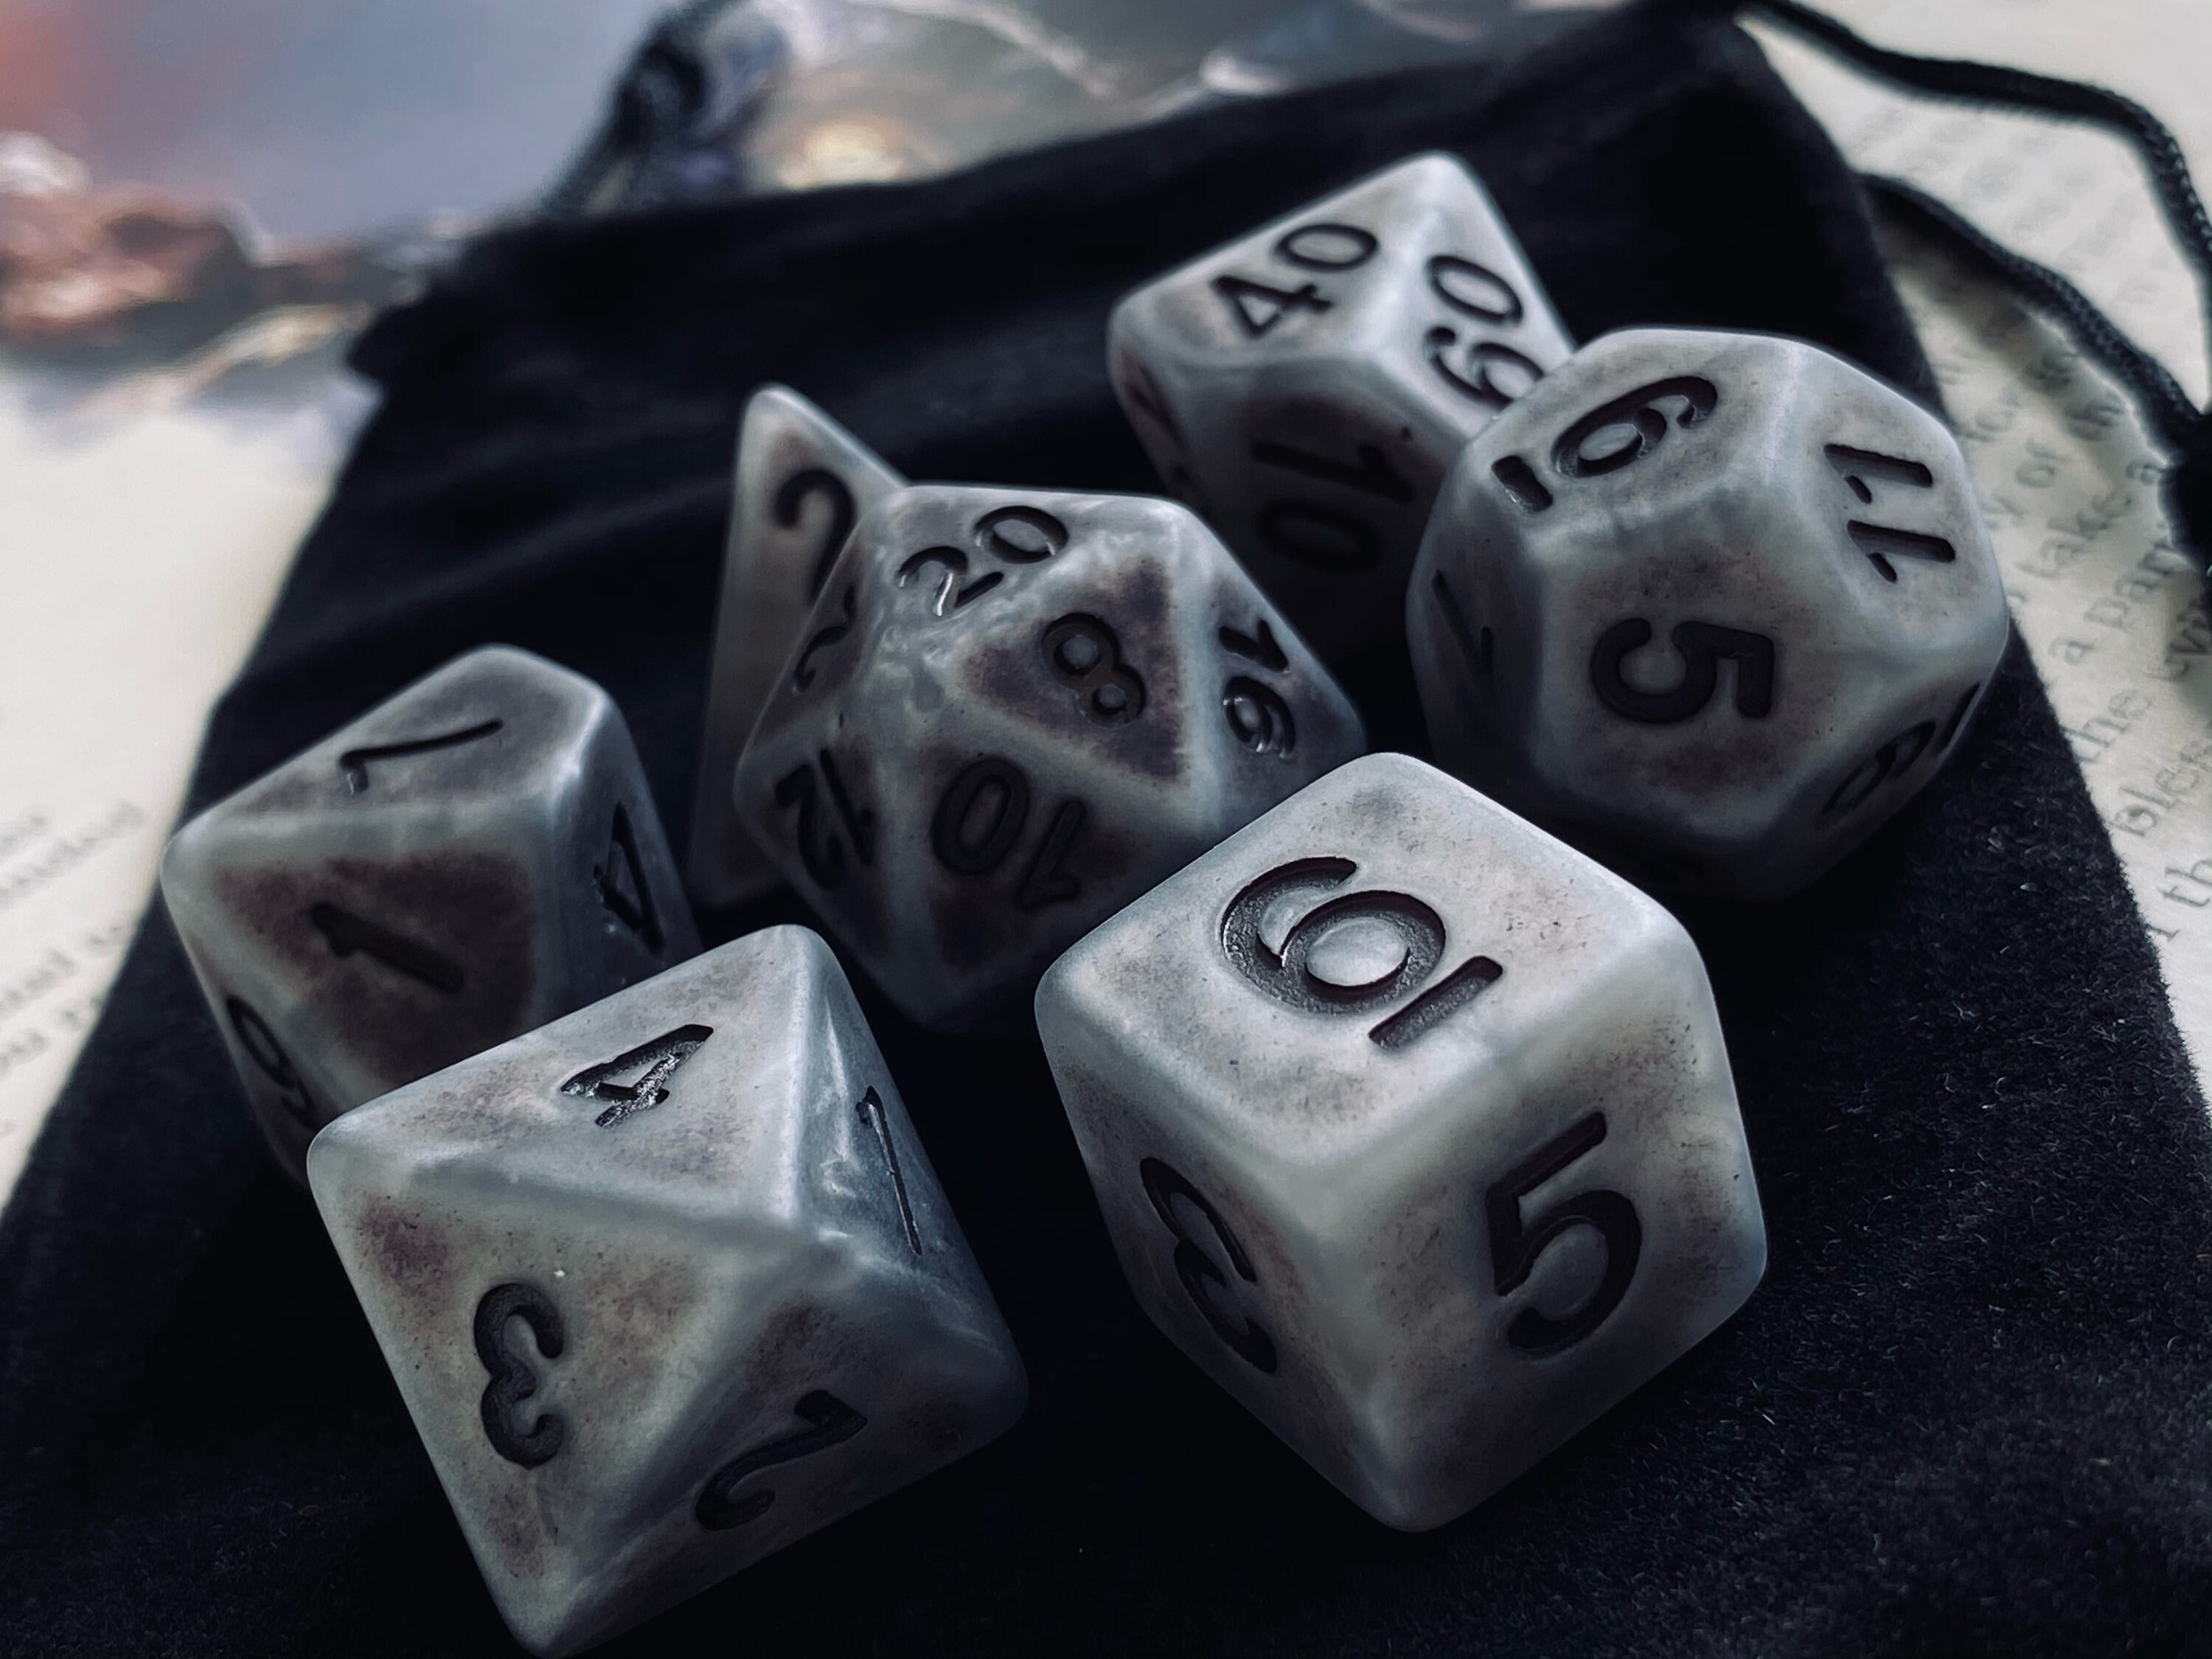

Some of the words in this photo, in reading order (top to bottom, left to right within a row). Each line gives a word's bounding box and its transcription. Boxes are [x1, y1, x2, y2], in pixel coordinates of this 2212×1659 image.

[1211, 223, 1379, 339] 40
[1425, 254, 1550, 408] 60
[895, 505, 1071, 618] 20
[1823, 442, 1957, 583] 11
[1040, 611, 1147, 727] 8
[1591, 616, 1776, 726] 5
[931, 755, 1091, 911] 10
[310, 901, 466, 995] 1
[1220, 855, 1506, 1053] 6
[560, 1023, 714, 1129] 4
[1138, 1155, 1279, 1374] 3
[1484, 1109, 1644, 1362] 5
[473, 1281, 566, 1470] 3
